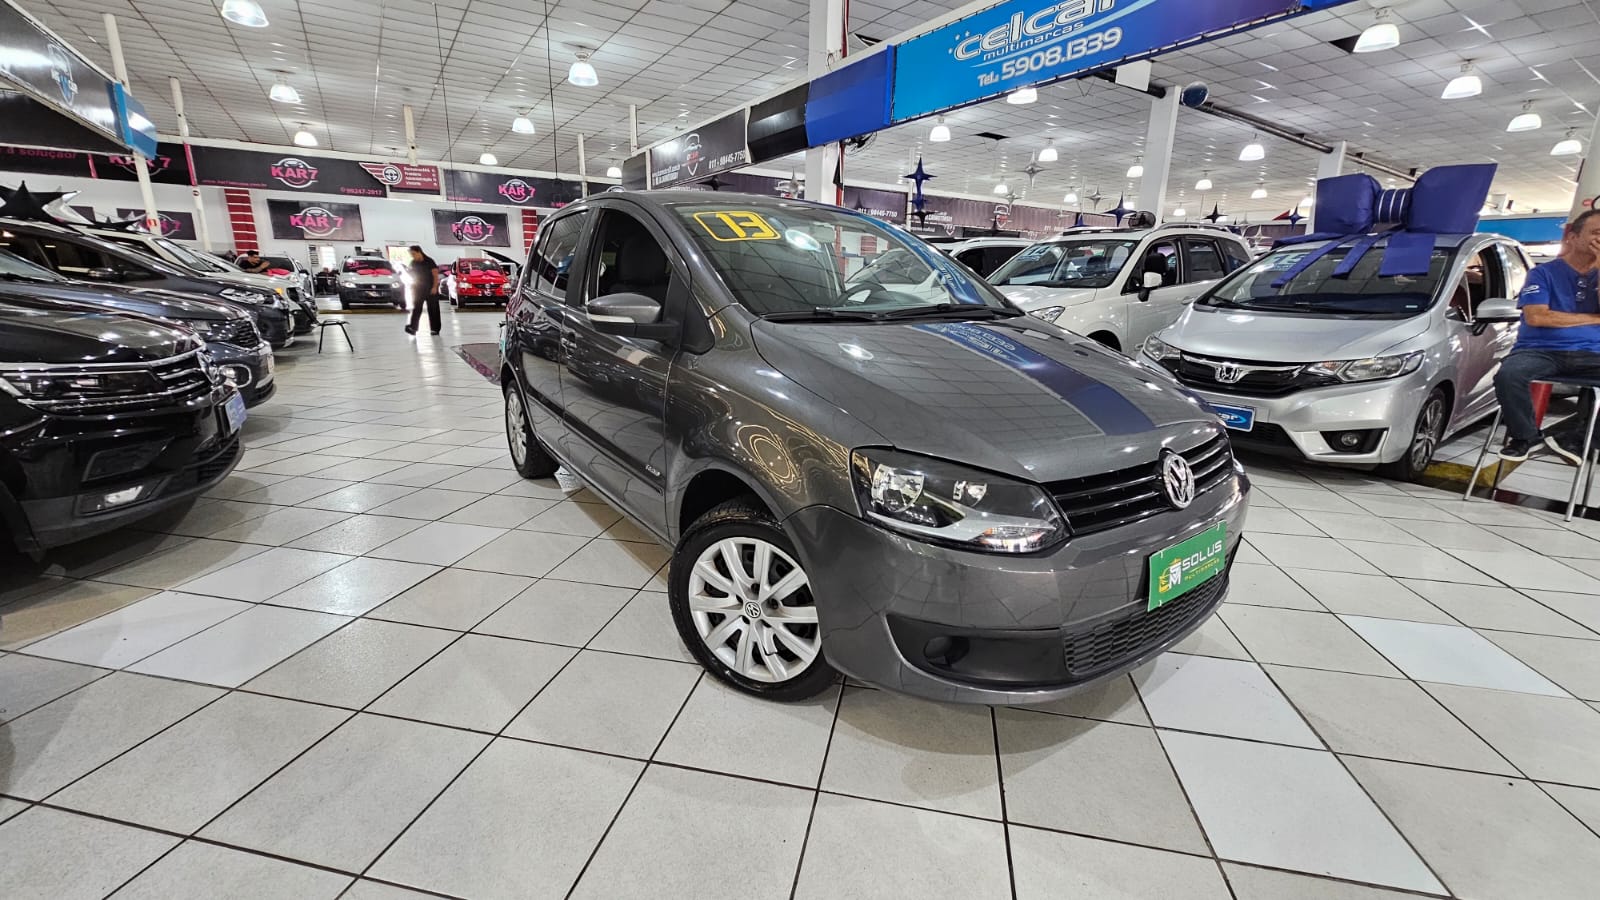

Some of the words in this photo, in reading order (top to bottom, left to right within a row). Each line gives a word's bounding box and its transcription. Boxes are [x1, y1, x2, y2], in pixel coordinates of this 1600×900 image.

[983, 21, 1084, 61] multimarcas
[1001, 26, 1123, 81] 5908.1339
[498, 185, 526, 197] KAR
[529, 187, 536, 198] 7
[289, 215, 330, 228] KAR
[333, 217, 344, 228] 7
[452, 223, 483, 235] KAR
[486, 225, 495, 236] 7
[715, 212, 775, 238] 13
[1182, 540, 1223, 571] SOLUS
